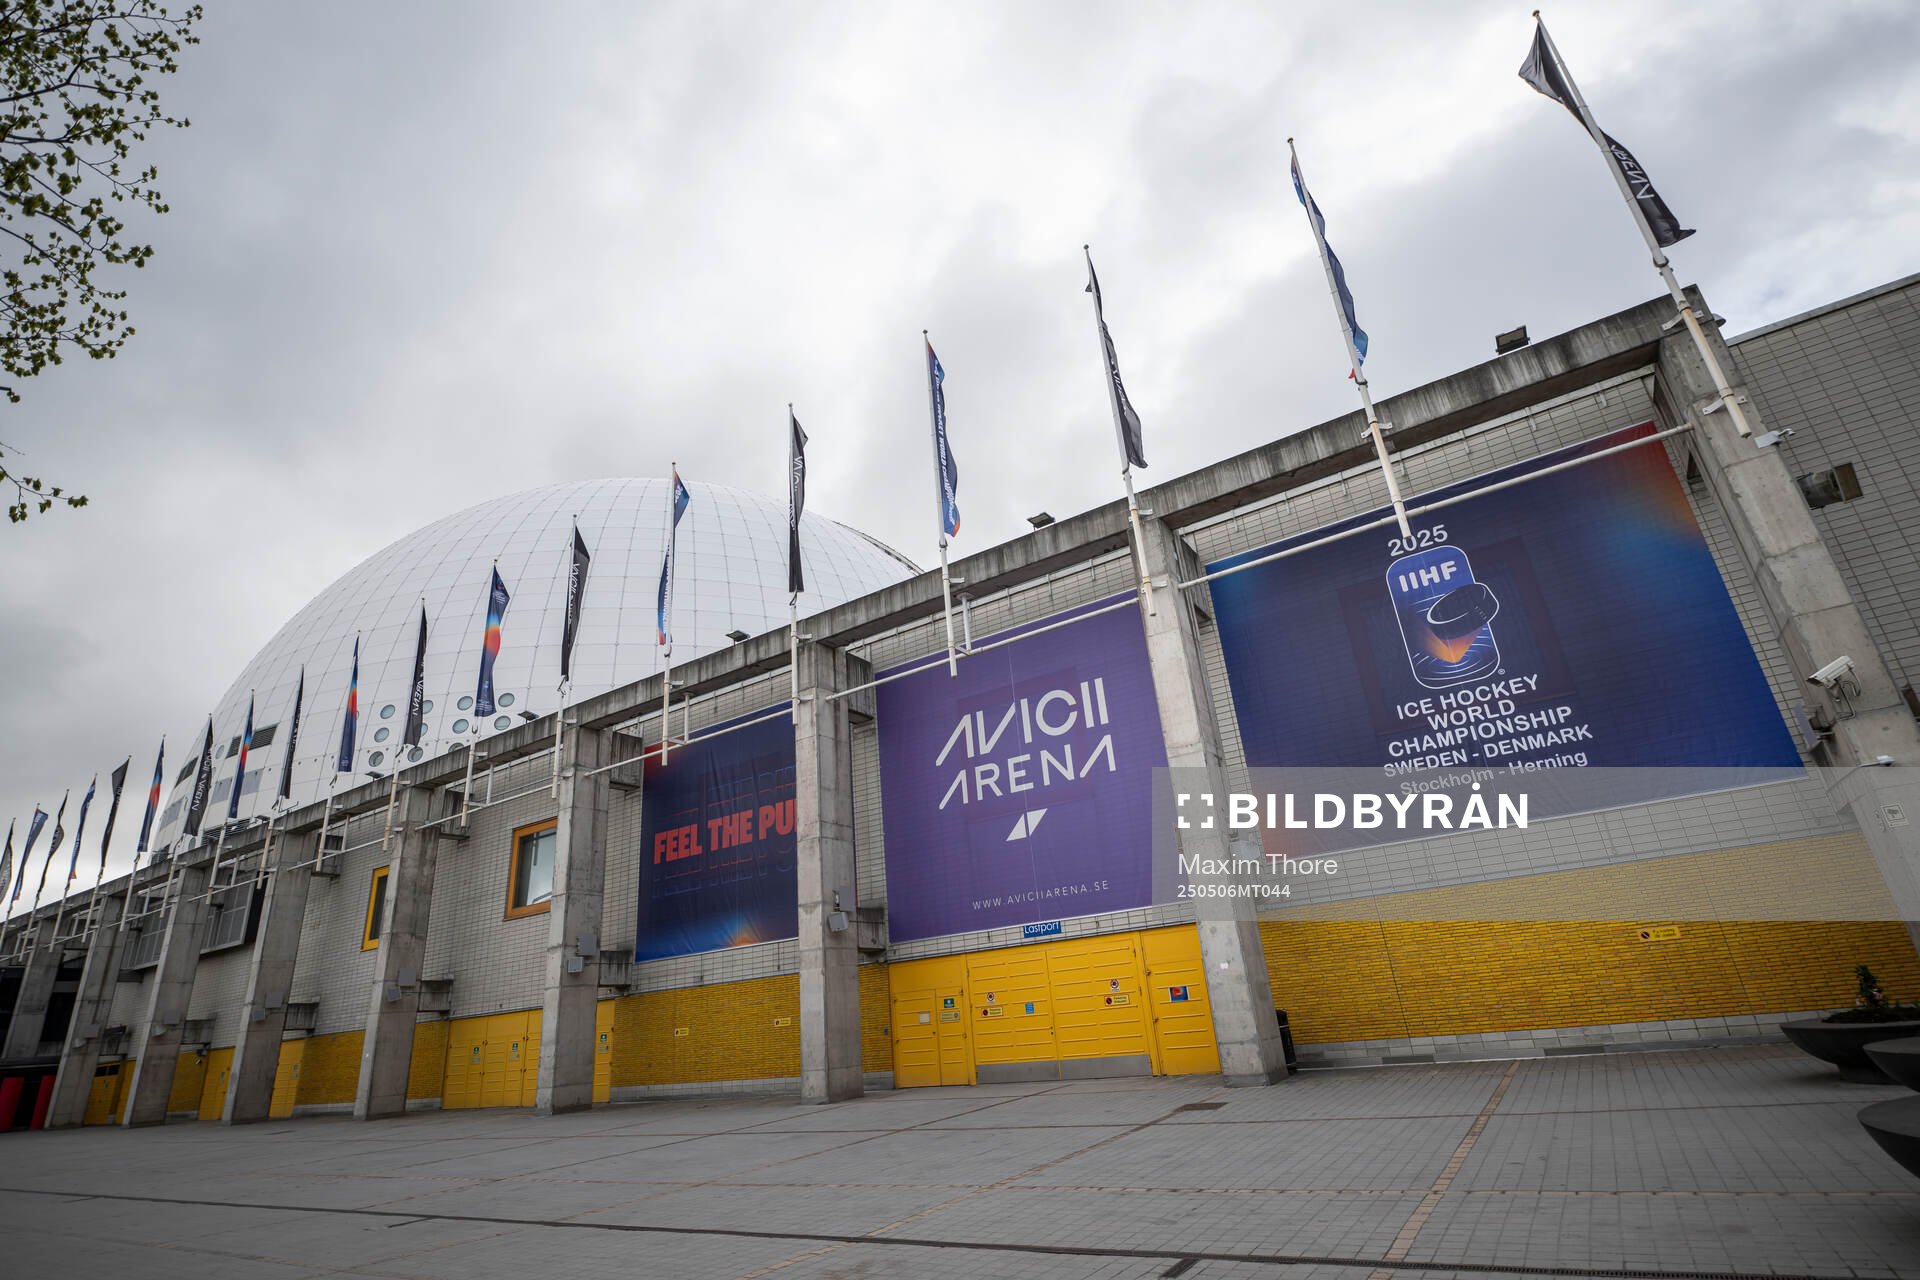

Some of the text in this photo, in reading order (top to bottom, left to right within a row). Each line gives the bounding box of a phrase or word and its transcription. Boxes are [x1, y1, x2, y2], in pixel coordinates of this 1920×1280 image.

[1388, 524, 1448, 557] 2025
[1399, 561, 1457, 592] IIHF
[1397, 674, 1538, 720] ICE HOCKEY
[1427, 699, 1515, 731] WORLD
[935, 677, 1109, 767] AVICII
[1388, 706, 1572, 757] CHAMPIONSHIP
[939, 734, 1117, 810] ARENA
[1384, 749, 1468, 777] SWEDEN
[1483, 724, 1594, 758] DENMARK
[1400, 768, 1494, 797] Stockholm
[1508, 751, 1588, 776] Herning
[653, 824, 702, 864] FEEL
[707, 809, 753, 851] THE
[972, 880, 1109, 910] WWW.AVICIIARENA.SE
[1024, 921, 1061, 935] Lastport
